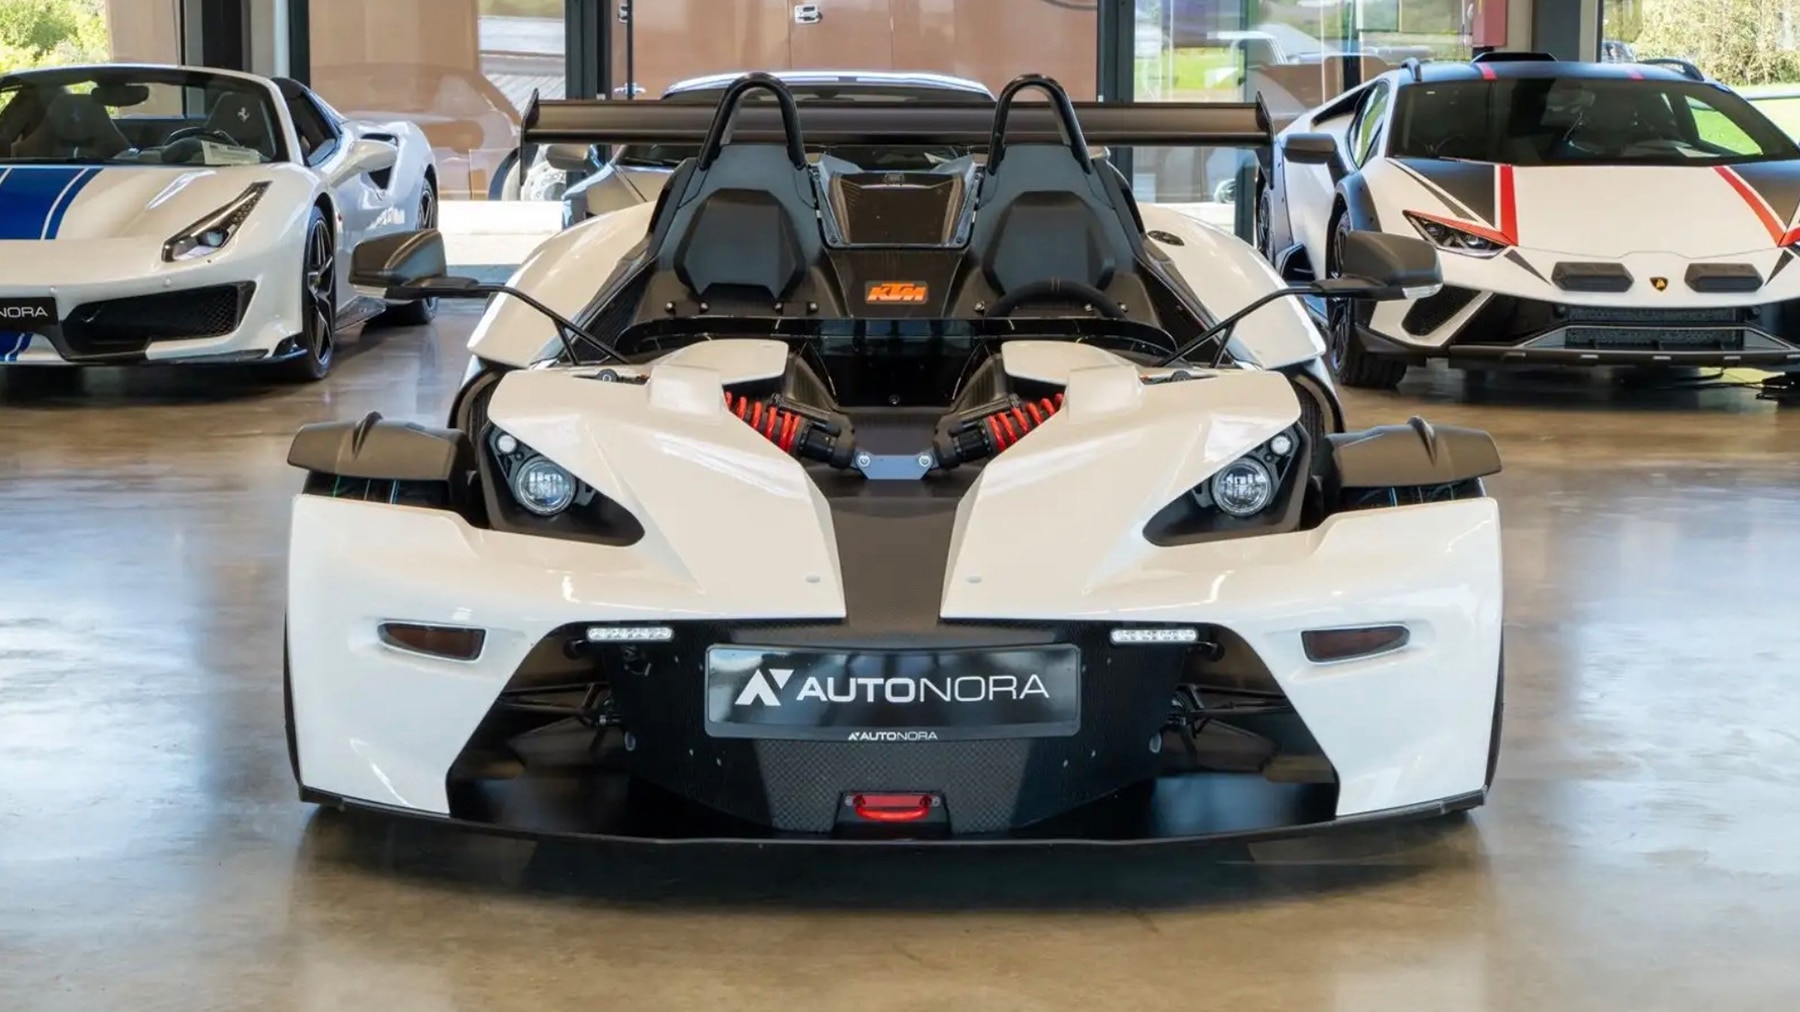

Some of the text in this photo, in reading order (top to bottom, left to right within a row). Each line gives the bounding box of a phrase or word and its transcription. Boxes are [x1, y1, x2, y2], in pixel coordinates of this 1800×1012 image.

[867, 283, 926, 301] KTM
[796, 674, 1050, 703] AUTONORA
[860, 731, 938, 741] AUTONORA
